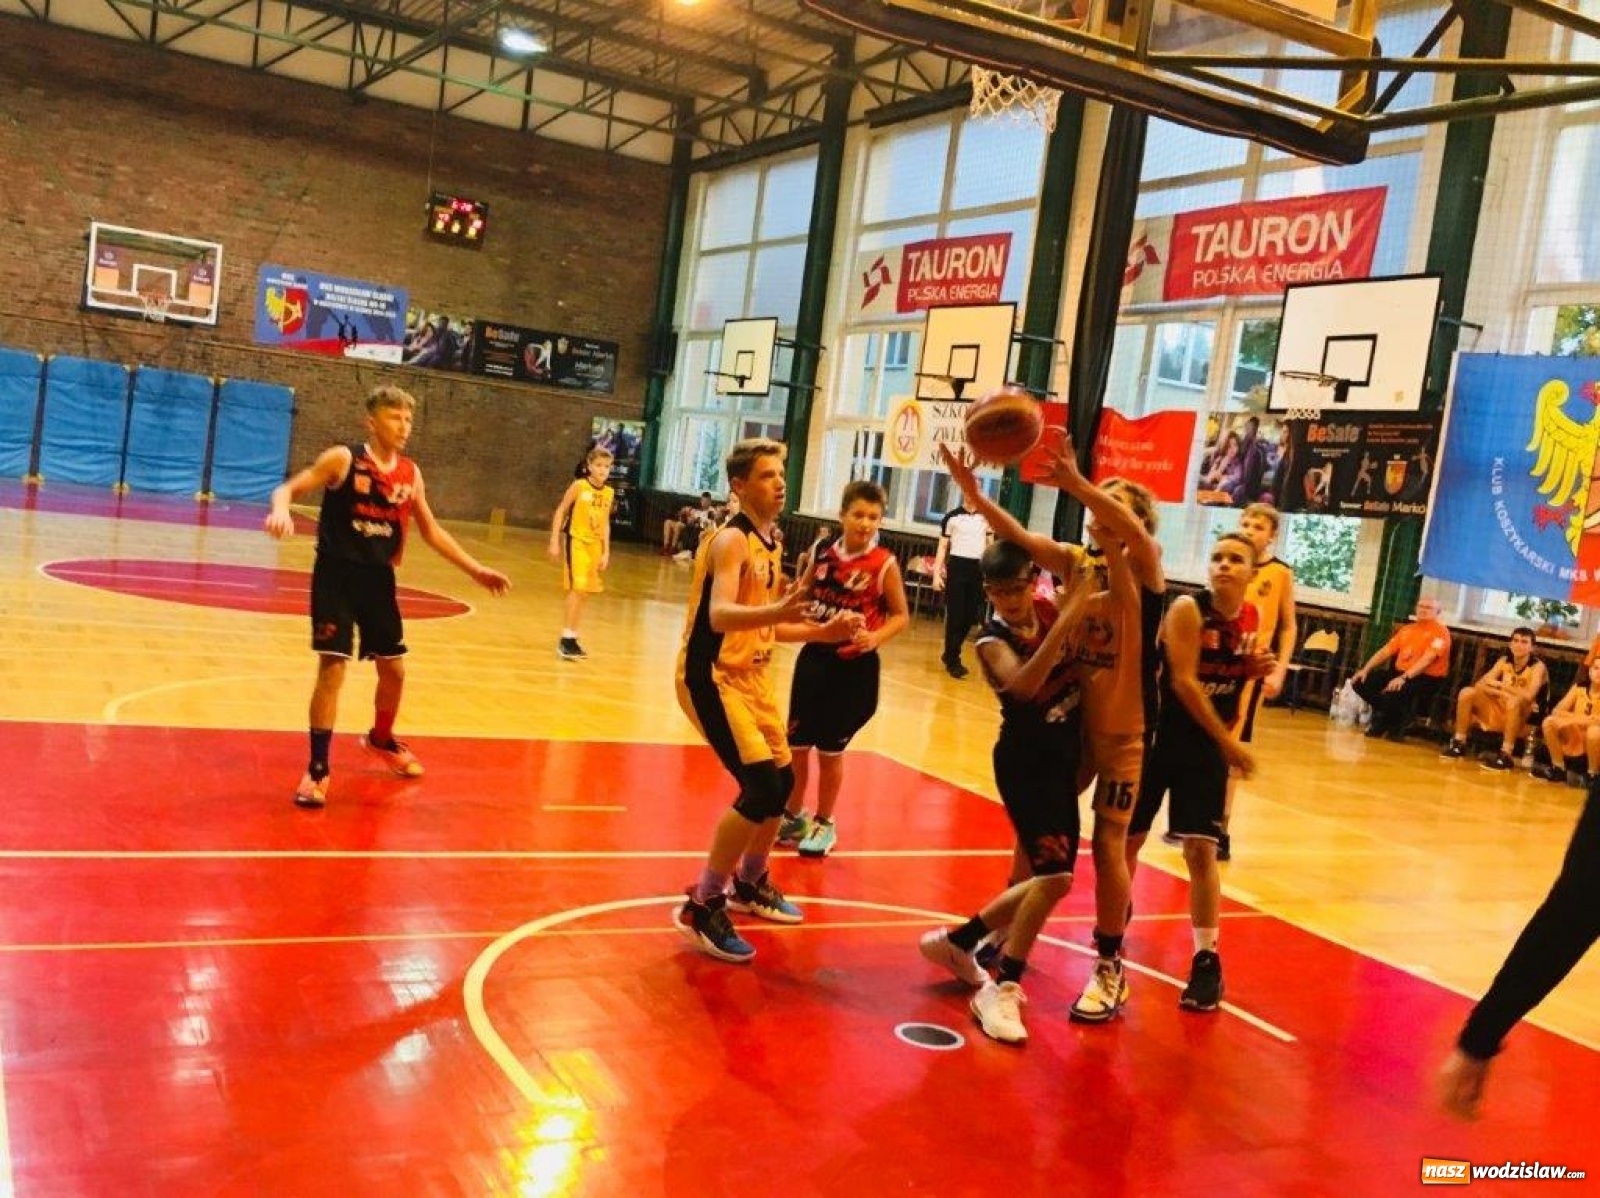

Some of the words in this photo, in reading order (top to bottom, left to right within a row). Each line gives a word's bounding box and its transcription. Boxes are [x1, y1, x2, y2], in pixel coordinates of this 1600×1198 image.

[1191, 208, 1353, 263] TAURON
[907, 244, 1005, 282] TAURON
[1193, 265, 1257, 288] POLSKA
[1261, 259, 1344, 283] ENERGIA
[949, 283, 998, 300] ENERGIA
[1307, 423, 1360, 443] BeSafe
[1491, 457, 1504, 496] KLUB
[1494, 499, 1556, 575] KOSZYKARSKI
[1558, 566, 1588, 582] MKS
[1106, 781, 1134, 811] 15
